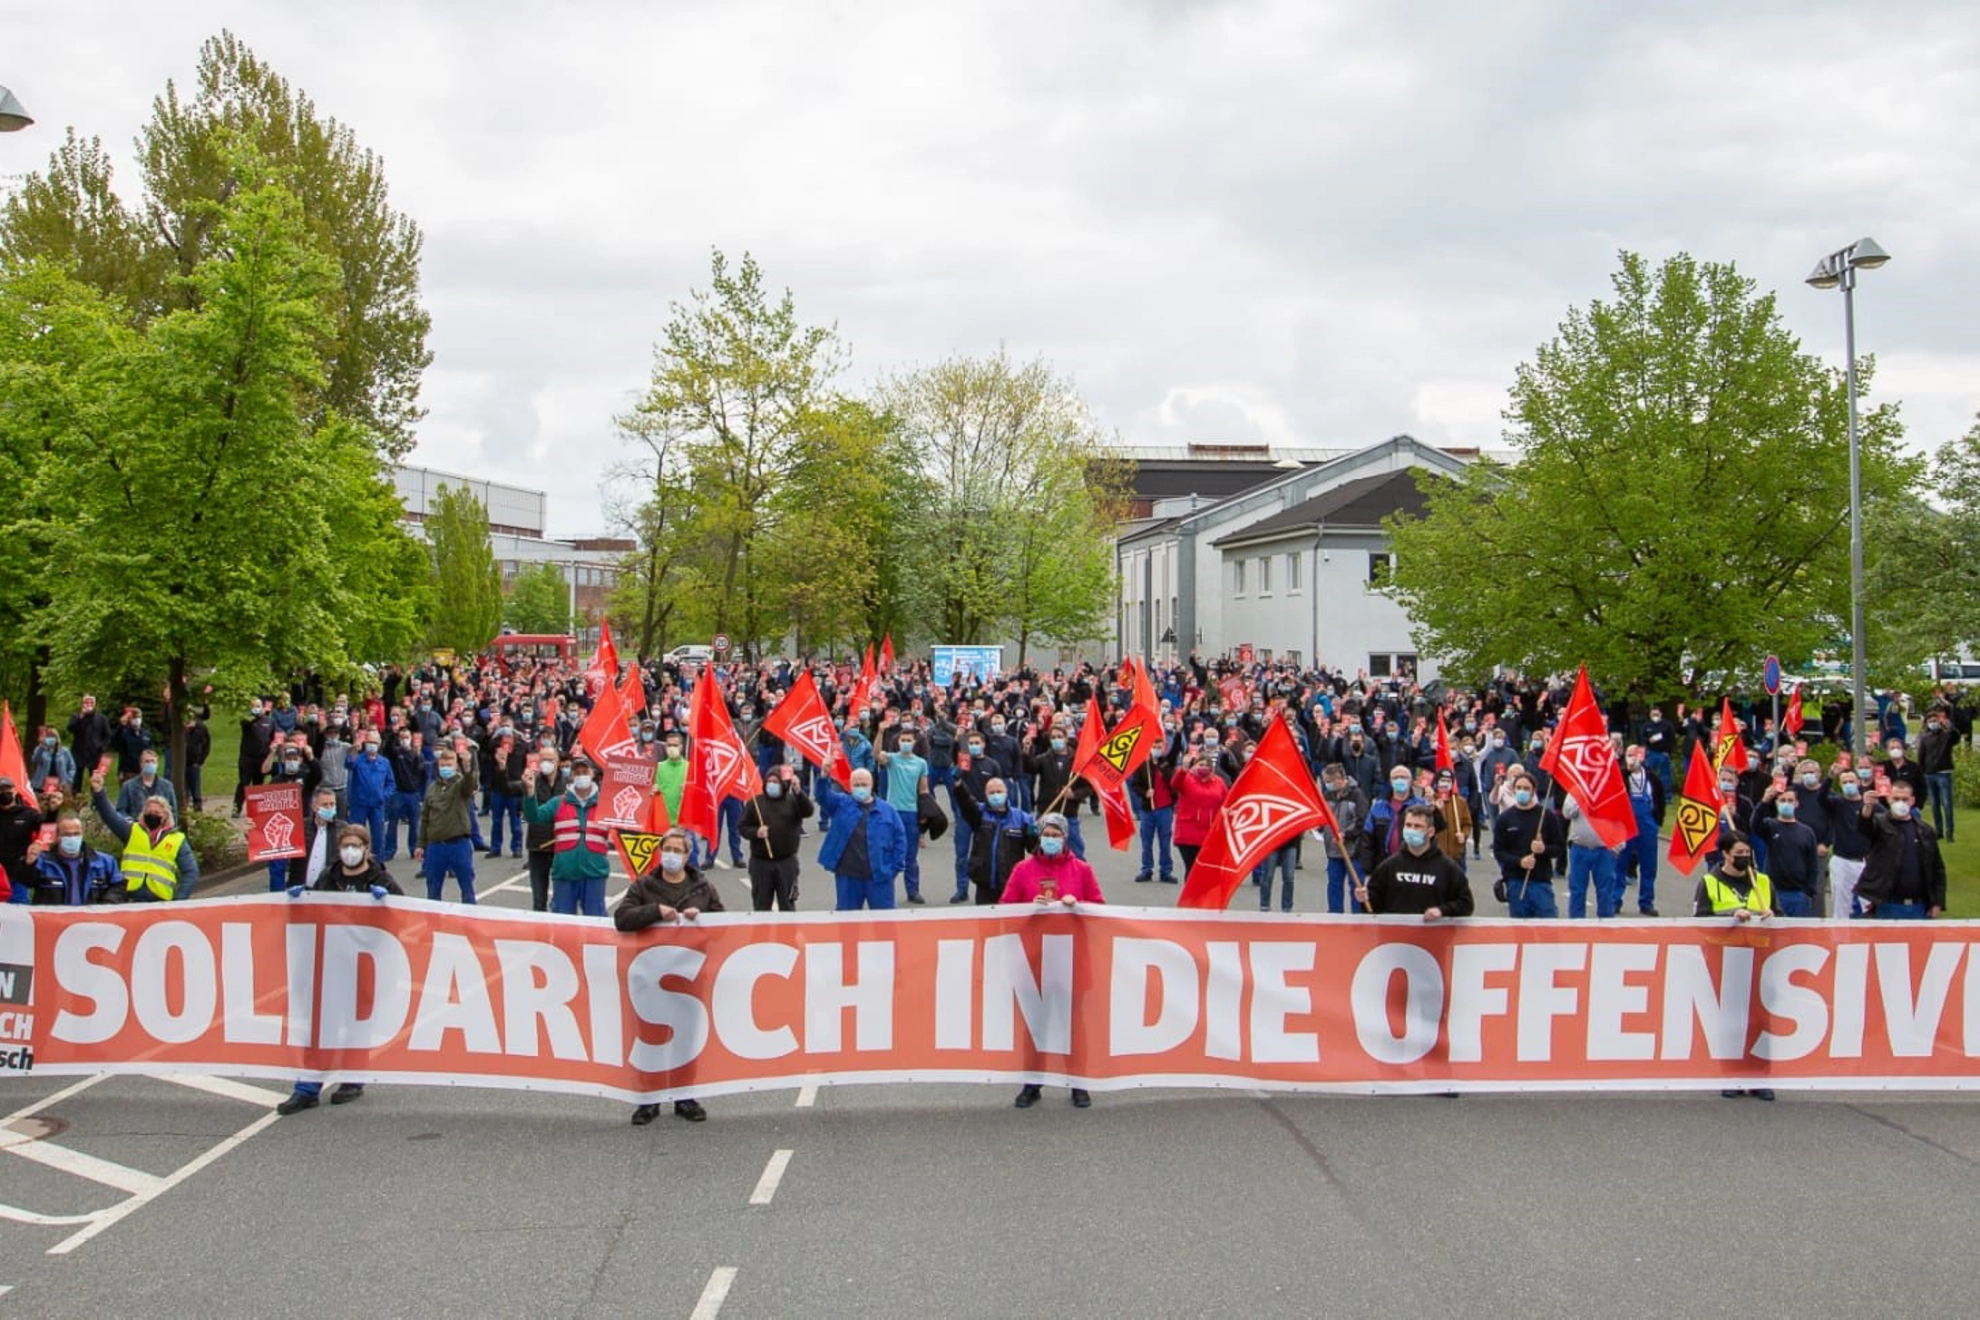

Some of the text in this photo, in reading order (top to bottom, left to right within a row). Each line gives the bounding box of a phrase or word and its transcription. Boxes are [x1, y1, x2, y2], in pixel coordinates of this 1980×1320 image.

[49, 920, 1980, 1073] SOLIDARISCH IN DIE OFFENSIV
